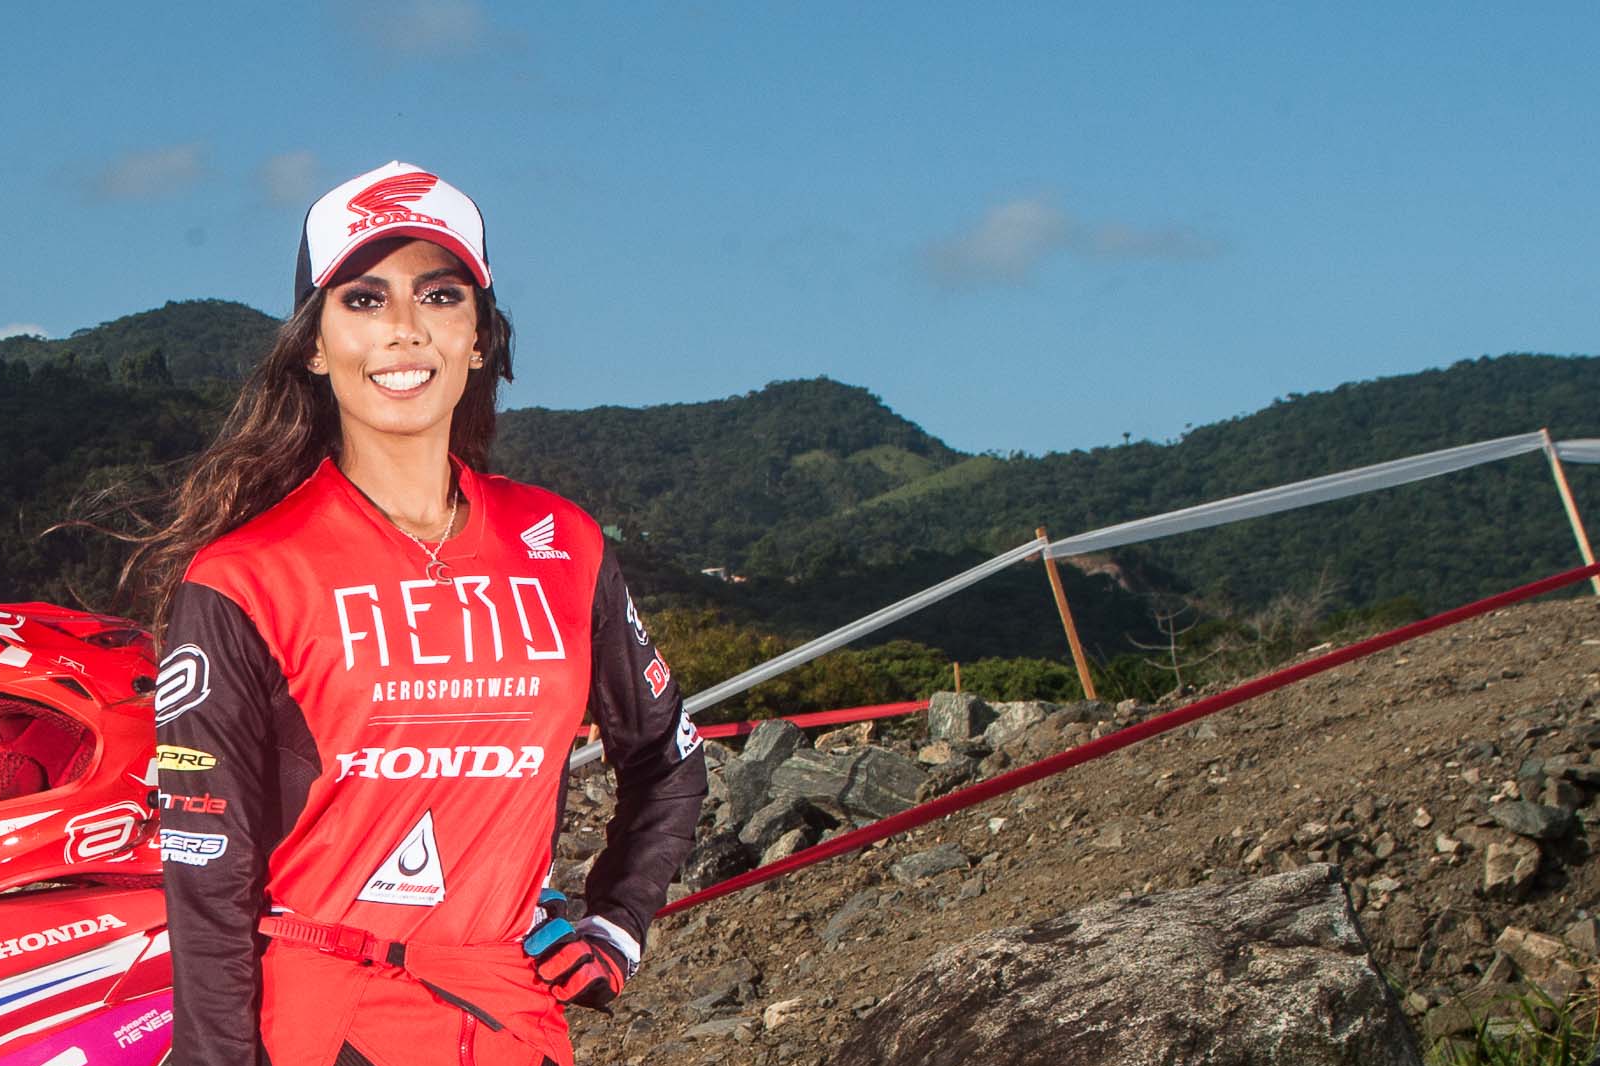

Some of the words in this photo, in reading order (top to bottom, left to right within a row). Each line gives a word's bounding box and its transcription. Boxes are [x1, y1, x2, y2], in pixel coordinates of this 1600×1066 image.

[347, 211, 447, 237] HONDA
[527, 549, 571, 561] HONDA
[333, 575, 566, 671] AERO
[372, 676, 541, 703] AEROSPORTWEAR
[335, 745, 545, 784] HONDA
[371, 880, 396, 891] Pro
[396, 882, 440, 894] Honda
